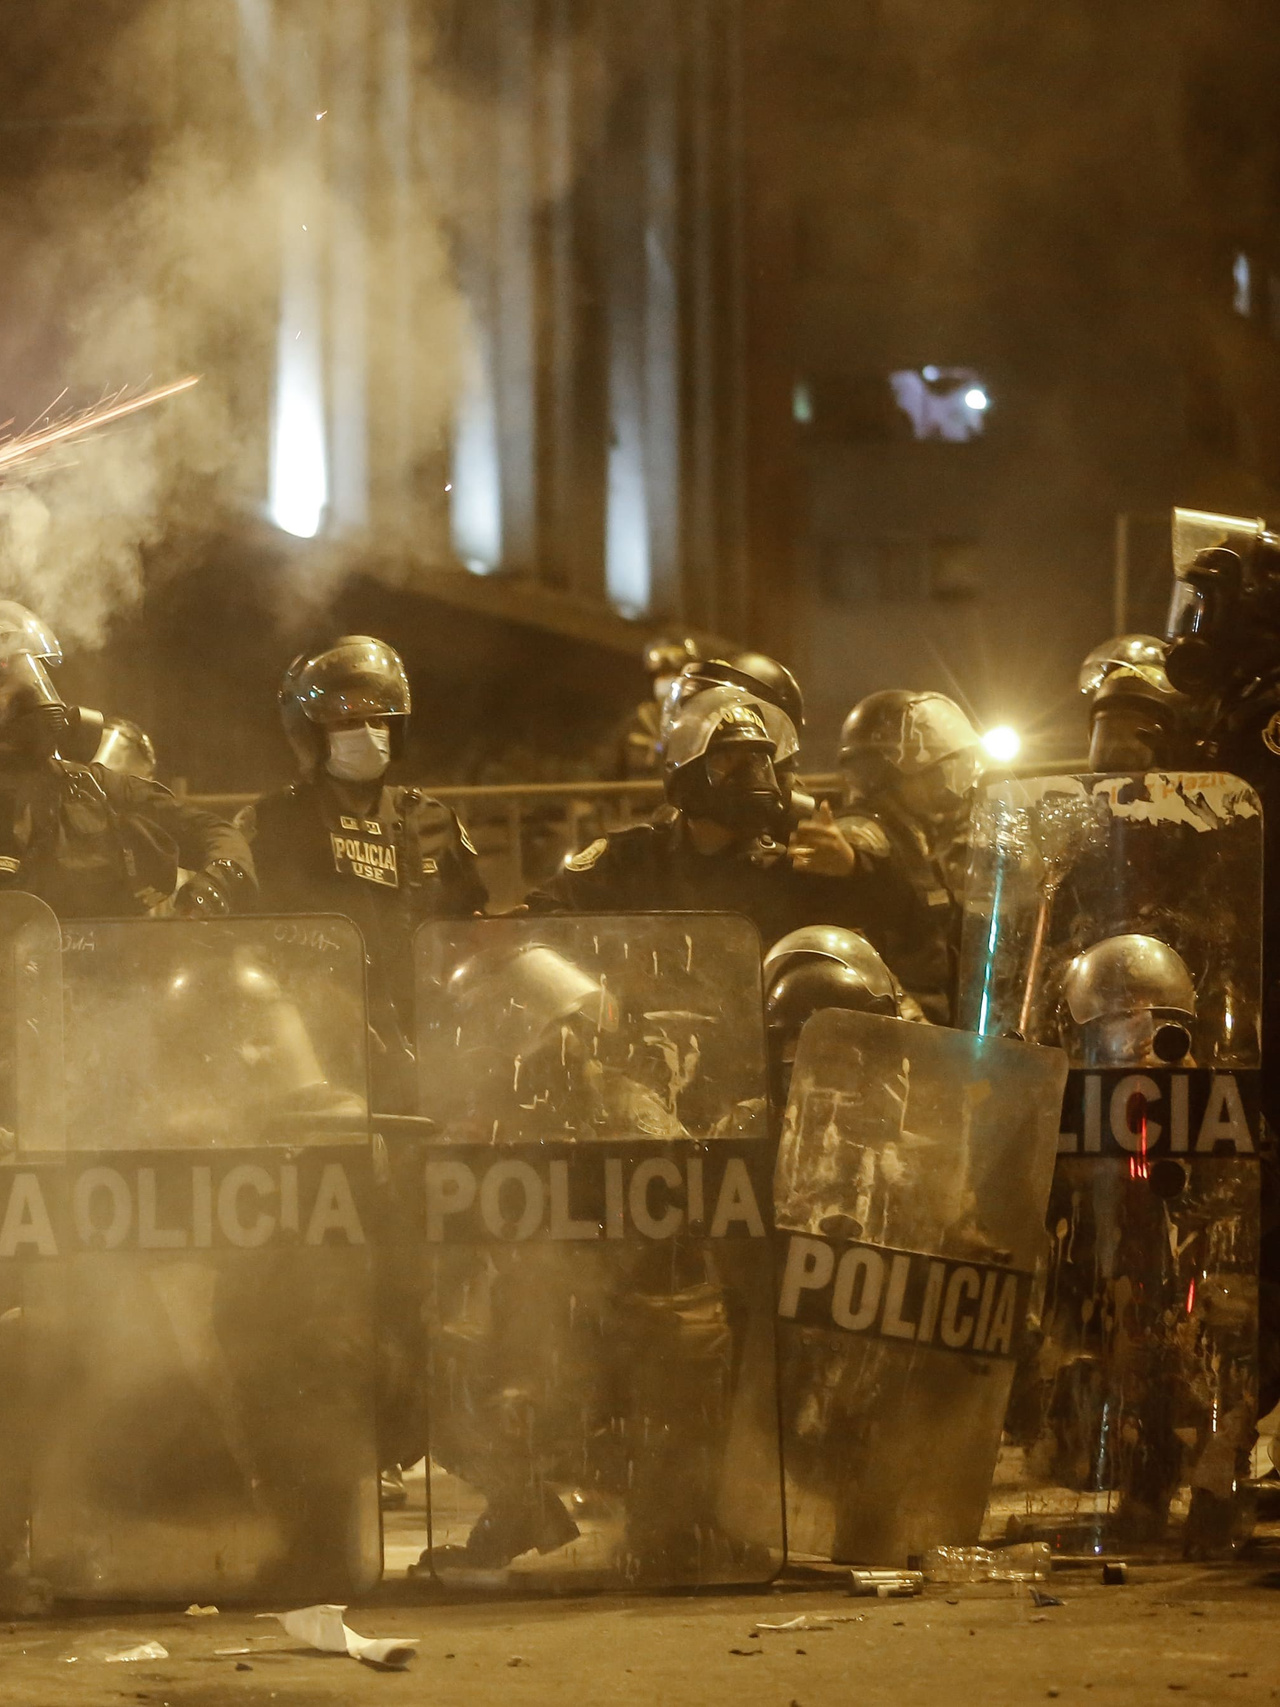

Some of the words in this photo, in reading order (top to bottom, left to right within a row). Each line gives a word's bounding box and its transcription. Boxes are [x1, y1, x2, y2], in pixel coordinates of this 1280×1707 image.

[333, 837, 395, 871] POLICIA
[351, 861, 385, 880] USE
[1057, 1073, 1255, 1153] ICIA
[73, 1163, 366, 1250] OLICIA
[424, 1157, 767, 1243] POLICIA
[777, 1236, 1019, 1355] POLICIA
